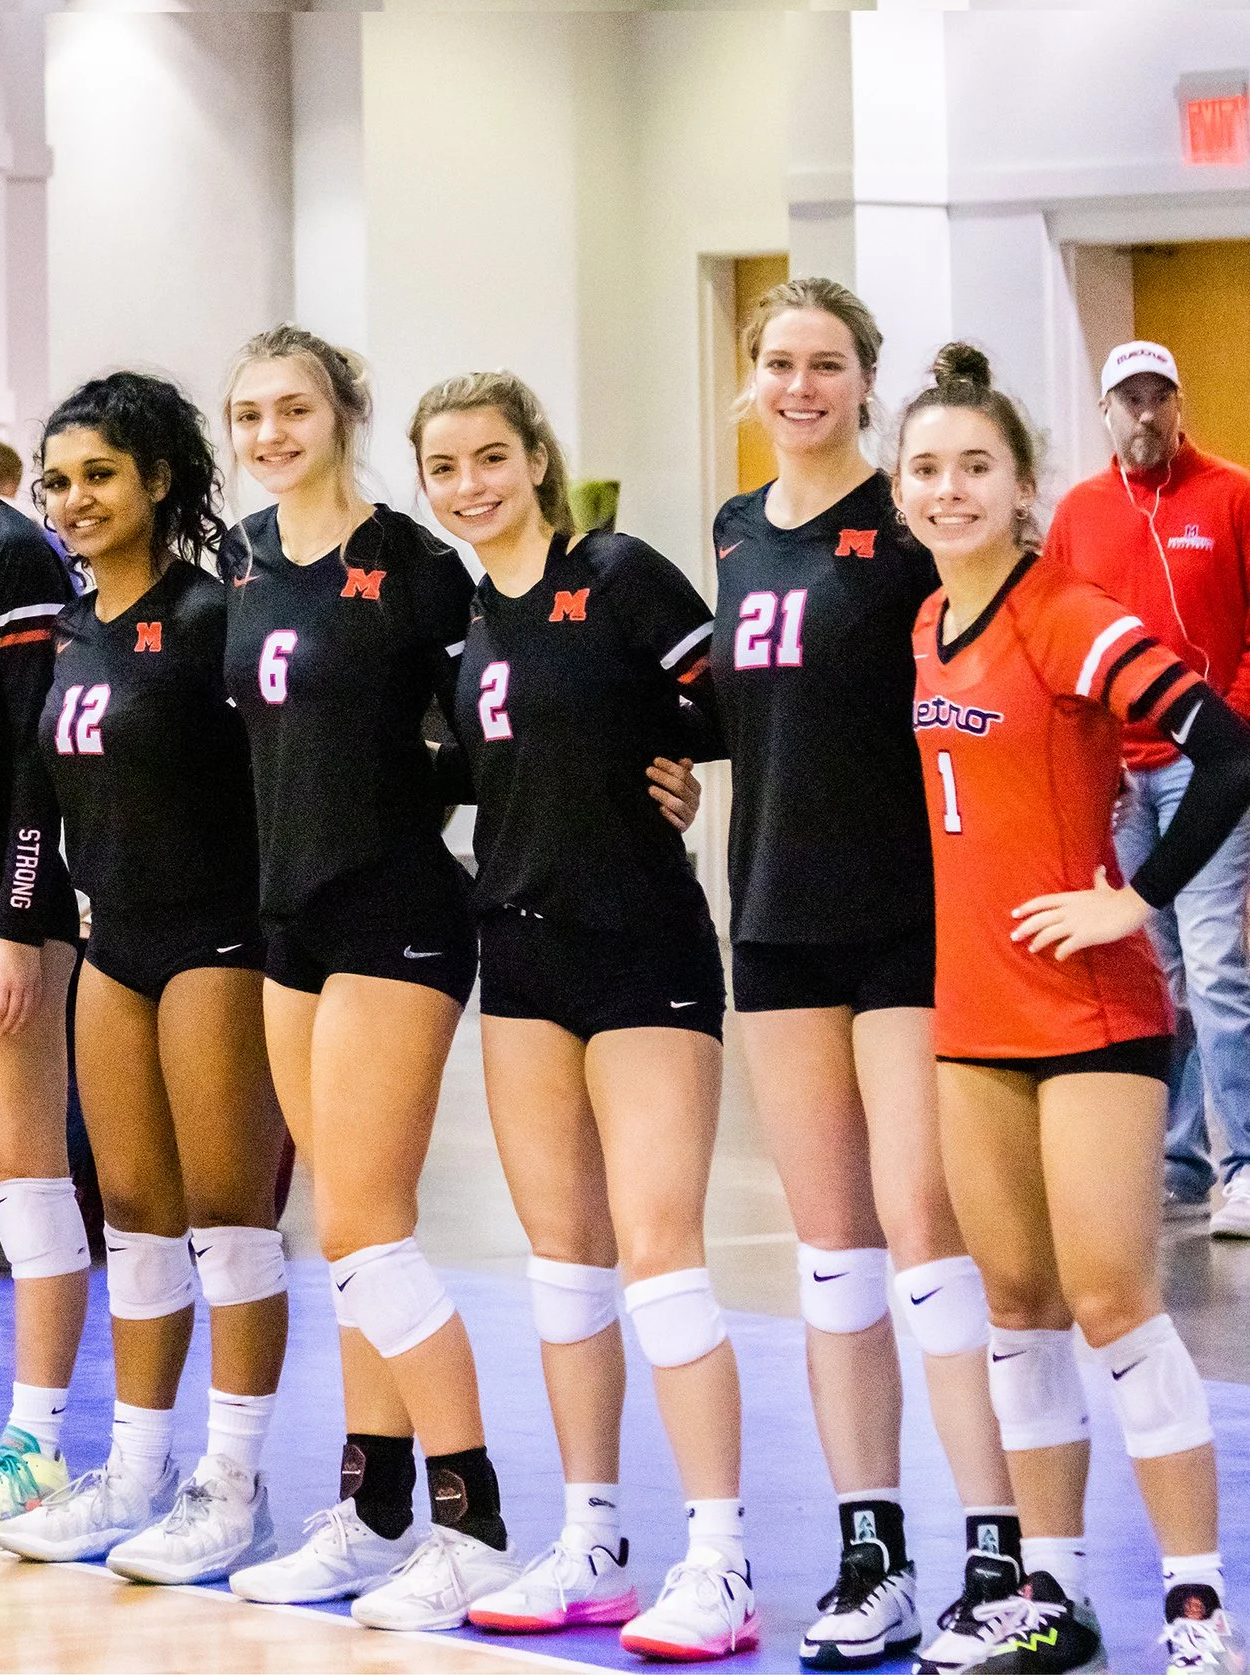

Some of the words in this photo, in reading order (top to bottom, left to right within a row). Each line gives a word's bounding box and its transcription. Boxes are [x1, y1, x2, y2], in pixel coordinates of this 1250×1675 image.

[834, 528, 878, 559] M
[340, 567, 387, 600] M
[548, 587, 591, 622] M
[133, 621, 163, 653] M
[734, 588, 808, 671] 21
[258, 629, 299, 705] 6
[478, 660, 513, 741] 2
[54, 683, 112, 756] 12
[912, 695, 1004, 737] etro
[936, 748, 964, 835] 1
[9, 828, 41, 910] STRONG
